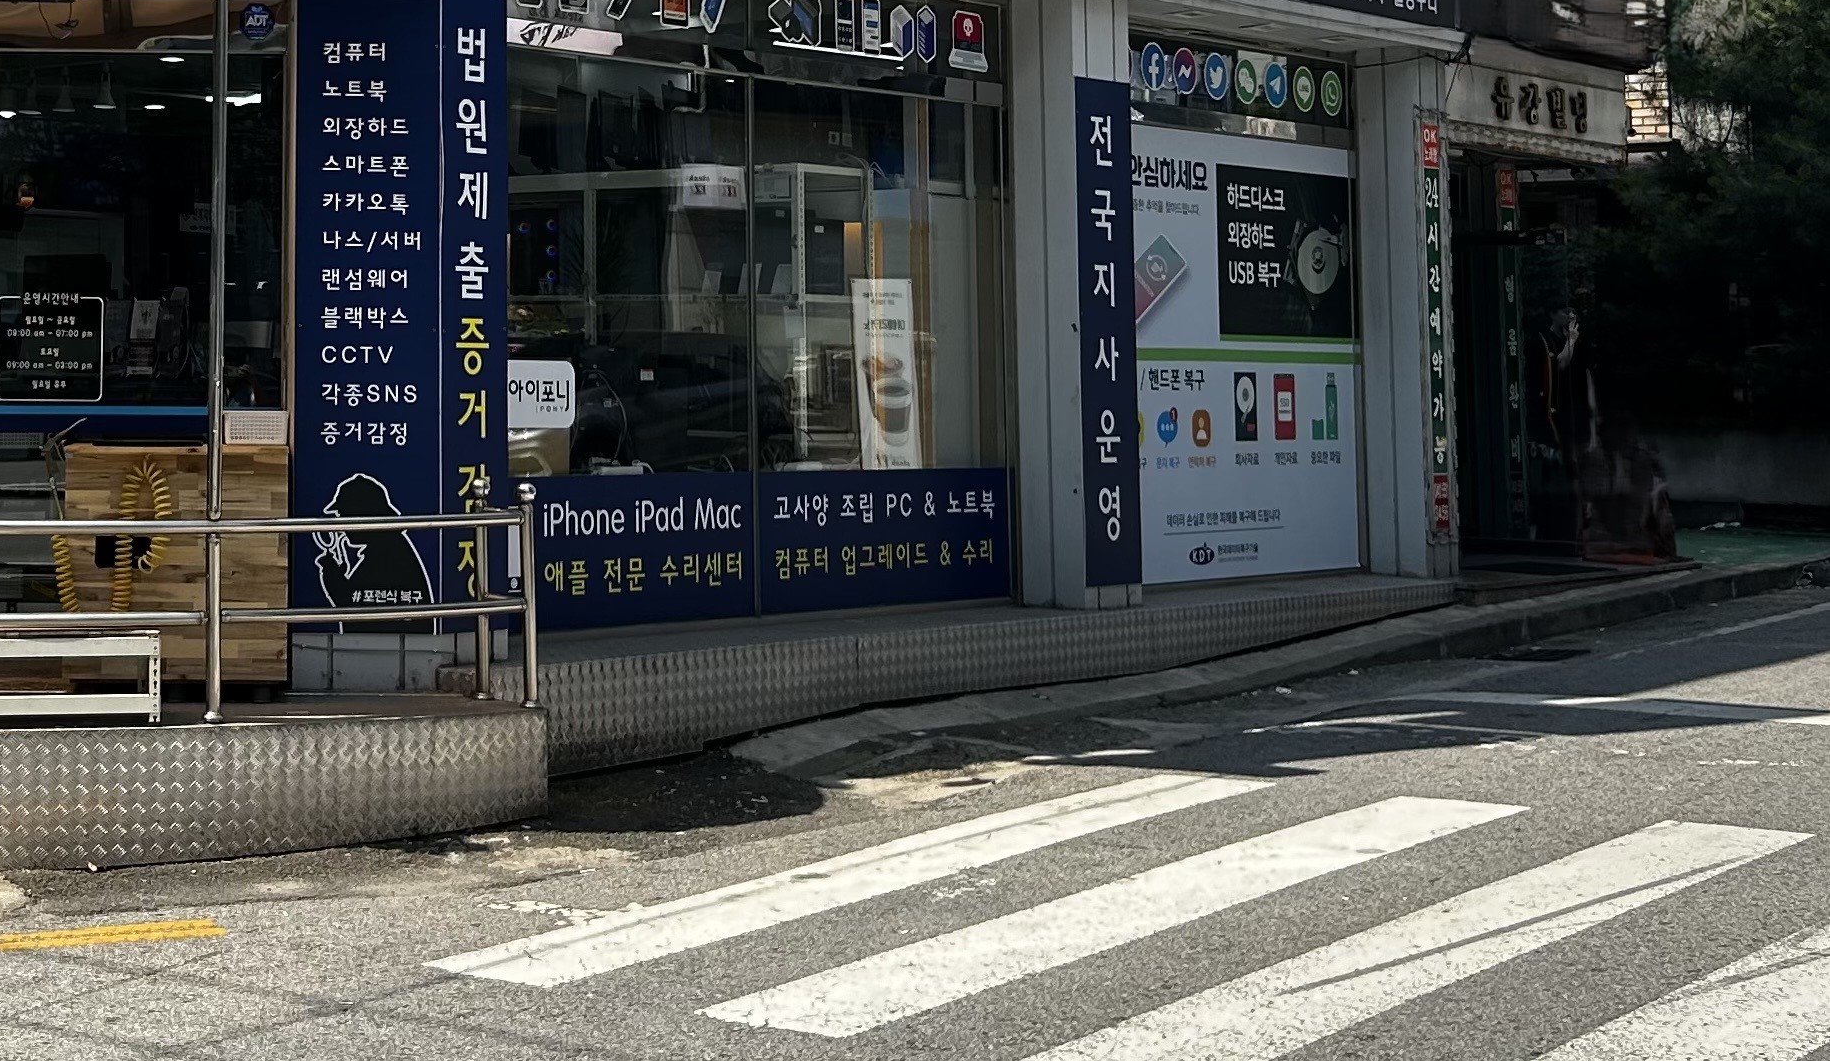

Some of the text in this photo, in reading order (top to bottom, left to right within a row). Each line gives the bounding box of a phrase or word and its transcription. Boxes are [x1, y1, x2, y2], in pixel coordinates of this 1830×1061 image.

[245, 14, 269, 27] ADT
[322, 42, 387, 64] 컴퓨터
[322, 80, 388, 102] 노트북
[322, 117, 410, 140] 외장하드
[1423, 128, 1437, 144] OK
[322, 155, 410, 178] 스마트폰
[1131, 155, 1208, 191] 안심하세요
[322, 192, 410, 215] 카카오톡
[1227, 182, 1286, 212] 하드디스크
[322, 231, 422, 253] 나스/서버
[1227, 221, 1276, 249] 외장하드
[322, 268, 409, 291] 랜섬웨어
[1228, 260, 1282, 288] USB 복구
[321, 306, 409, 330] 블랙박스
[1088, 114, 1122, 542] 전국지사운영
[321, 345, 395, 365] CCTV
[1183, 369, 1205, 391] 복구
[321, 383, 418, 407] 각종SNS
[508, 379, 570, 412] 아이포니
[321, 422, 408, 445] 증거감정
[542, 497, 742, 538] iPhone iPad Mac
[773, 489, 996, 528] 고사양 조립 PC & 노트북
[774, 538, 994, 580] 컴퓨터 업그레이드 & 수리
[1192, 549, 1212, 563] KDT
[543, 550, 744, 596] 애플 전문 수리센터
